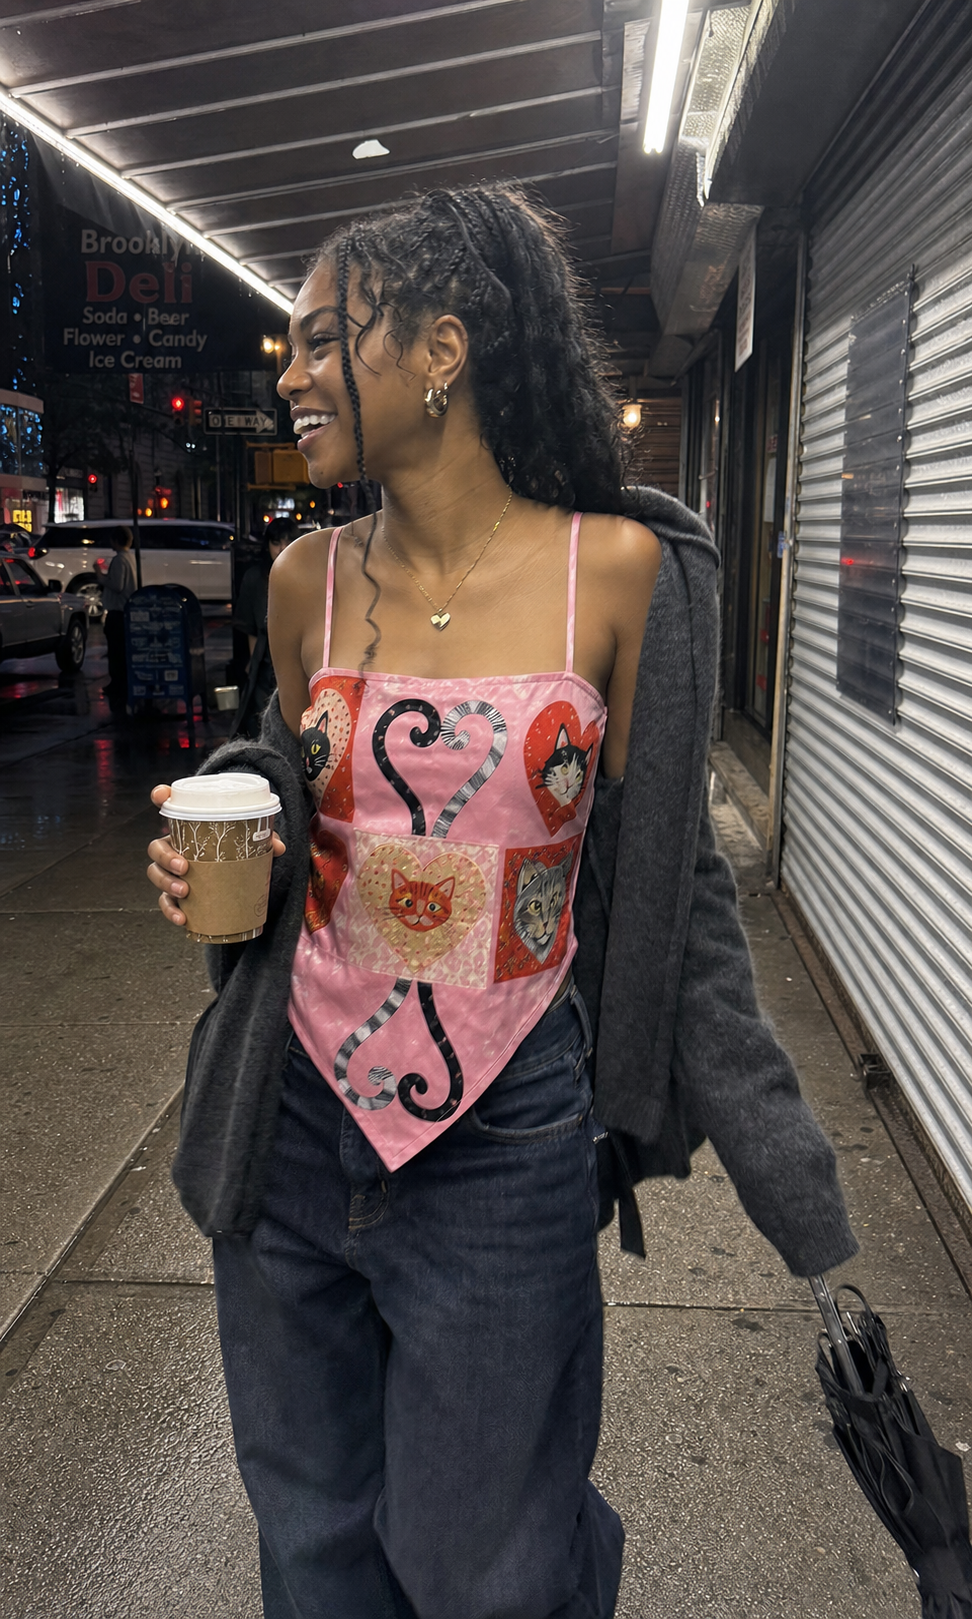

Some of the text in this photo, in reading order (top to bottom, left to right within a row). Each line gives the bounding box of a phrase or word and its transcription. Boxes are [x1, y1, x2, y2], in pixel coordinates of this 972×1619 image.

[84, 261, 193, 303] Deli
[82, 306, 190, 326] Soda Beer
[63, 328, 208, 352] Flower Candy
[89, 351, 182, 369] Ice Cream
[212, 416, 267, 426] OE WAY
